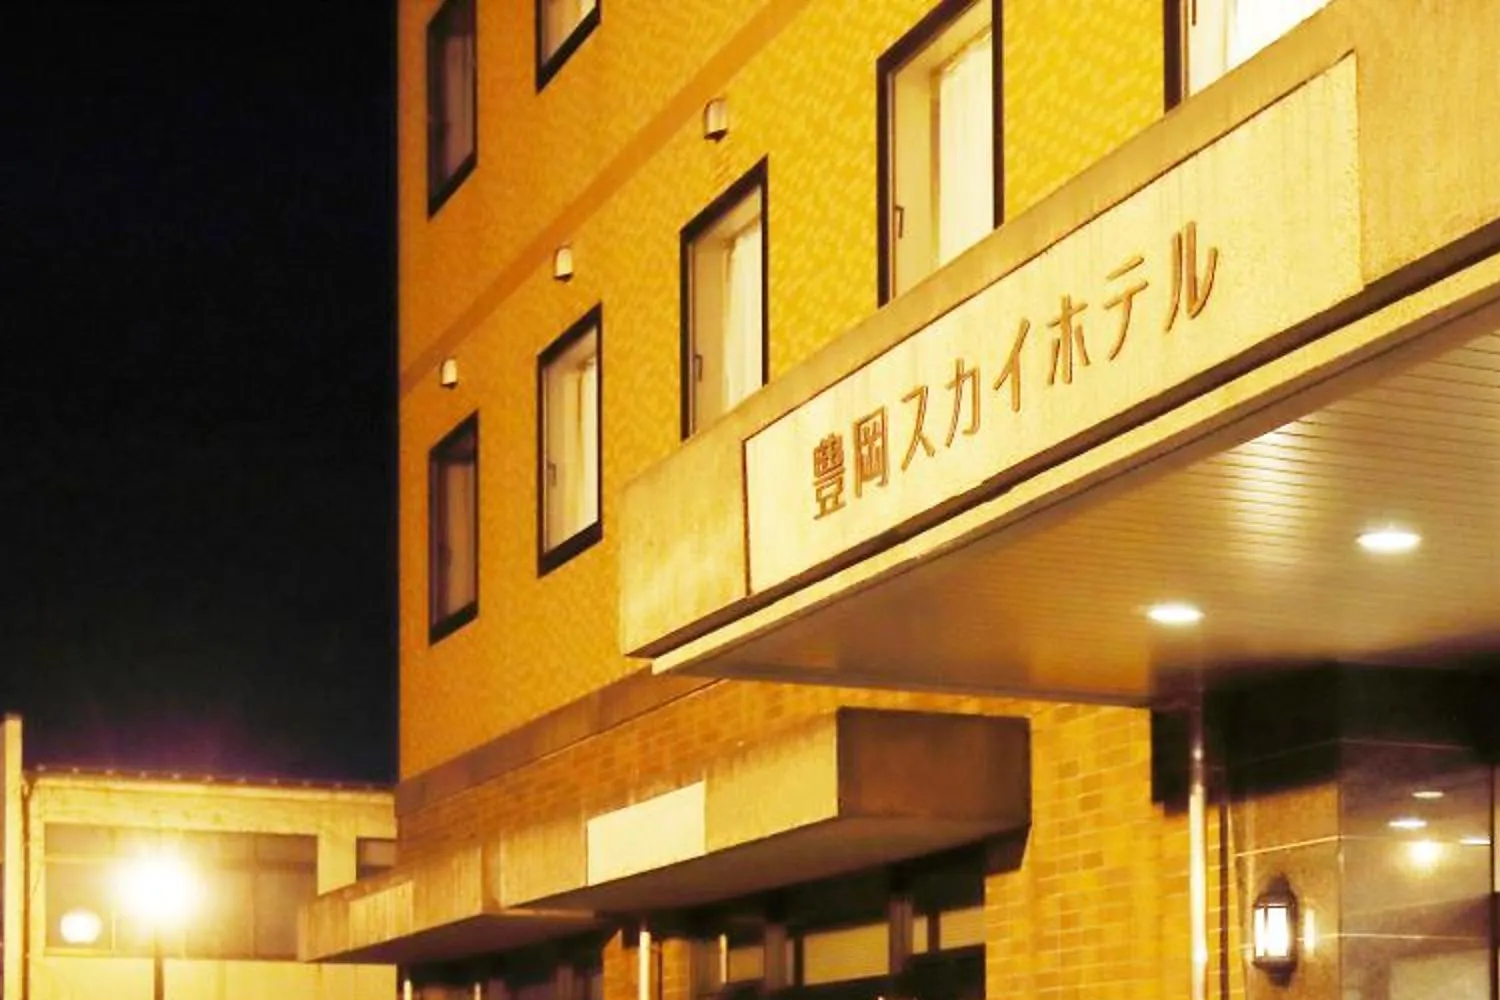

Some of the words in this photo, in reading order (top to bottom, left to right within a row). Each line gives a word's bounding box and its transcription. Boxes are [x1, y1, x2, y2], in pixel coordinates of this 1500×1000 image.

[812, 221, 1219, 520] 豊岡スカイホテル
